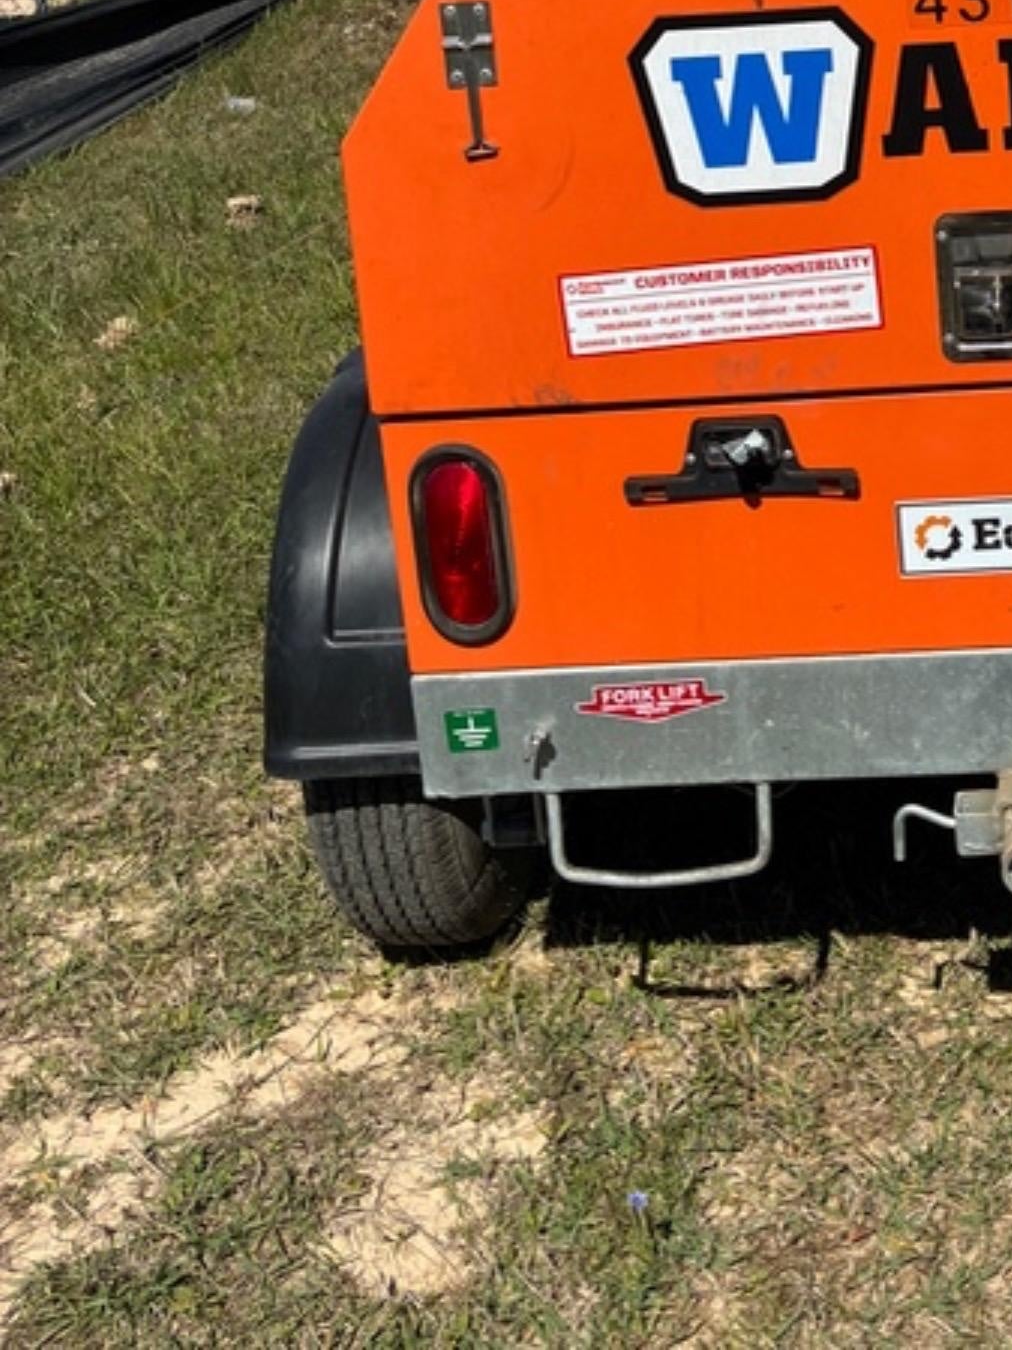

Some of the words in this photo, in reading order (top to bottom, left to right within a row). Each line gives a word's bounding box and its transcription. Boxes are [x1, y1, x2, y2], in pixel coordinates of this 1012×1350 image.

[634, 269, 727, 289] CUSTOMER
[730, 255, 870, 280] RESPONSIBILITY
[602, 687, 654, 706] FORK
[657, 683, 700, 700] LIFT
